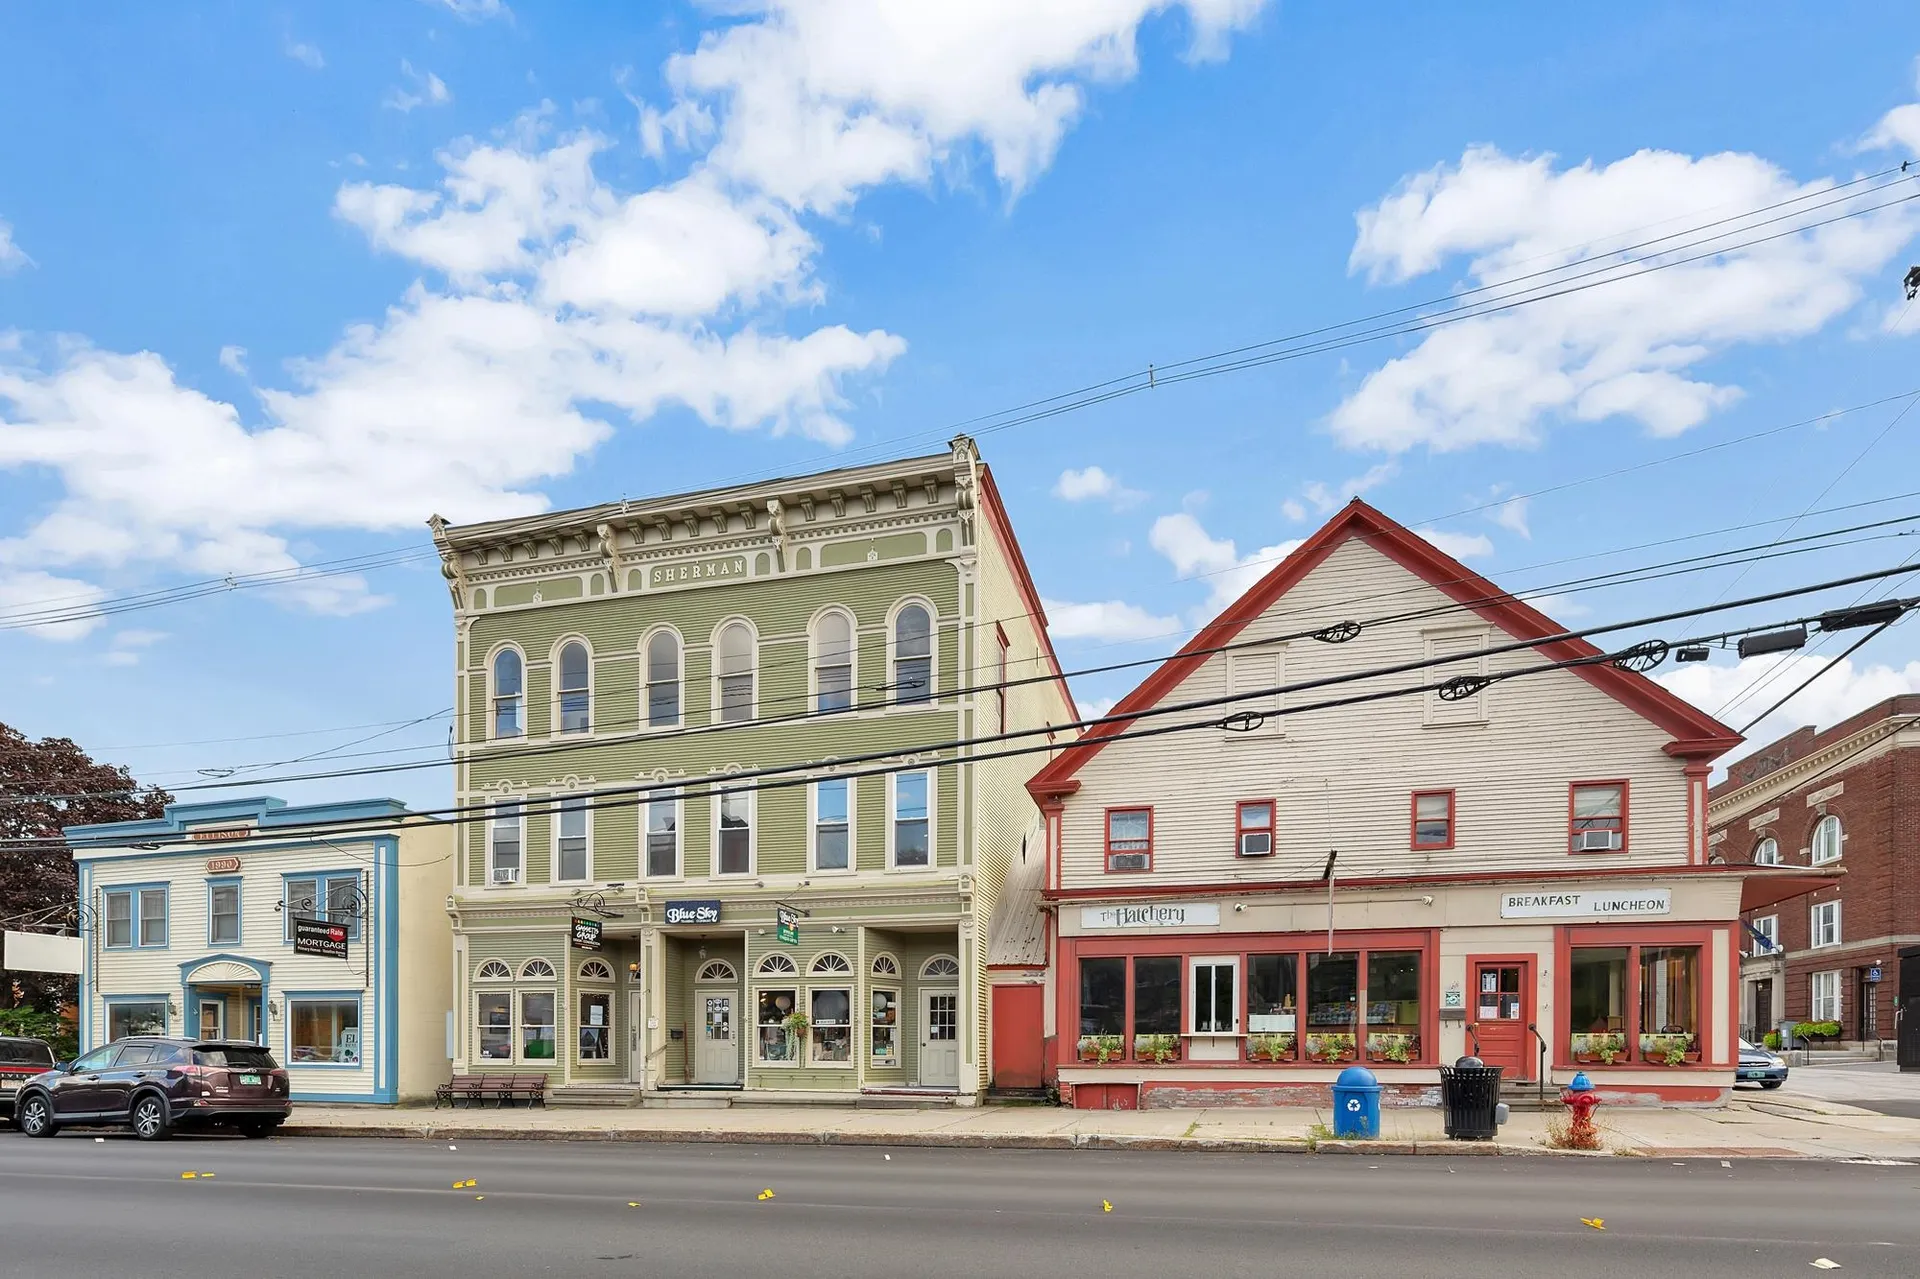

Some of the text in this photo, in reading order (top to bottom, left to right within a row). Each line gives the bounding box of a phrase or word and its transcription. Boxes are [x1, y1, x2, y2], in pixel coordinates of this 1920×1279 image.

[654, 560, 743, 582] SHERMAN
[1508, 895, 1665, 912] BREAKFAST LUNCHEON
[666, 906, 718, 923] Blue Sky
[1116, 905, 1185, 926] Hatchery
[330, 928, 344, 937] Rate
[297, 937, 346, 950] MORTGAGE
